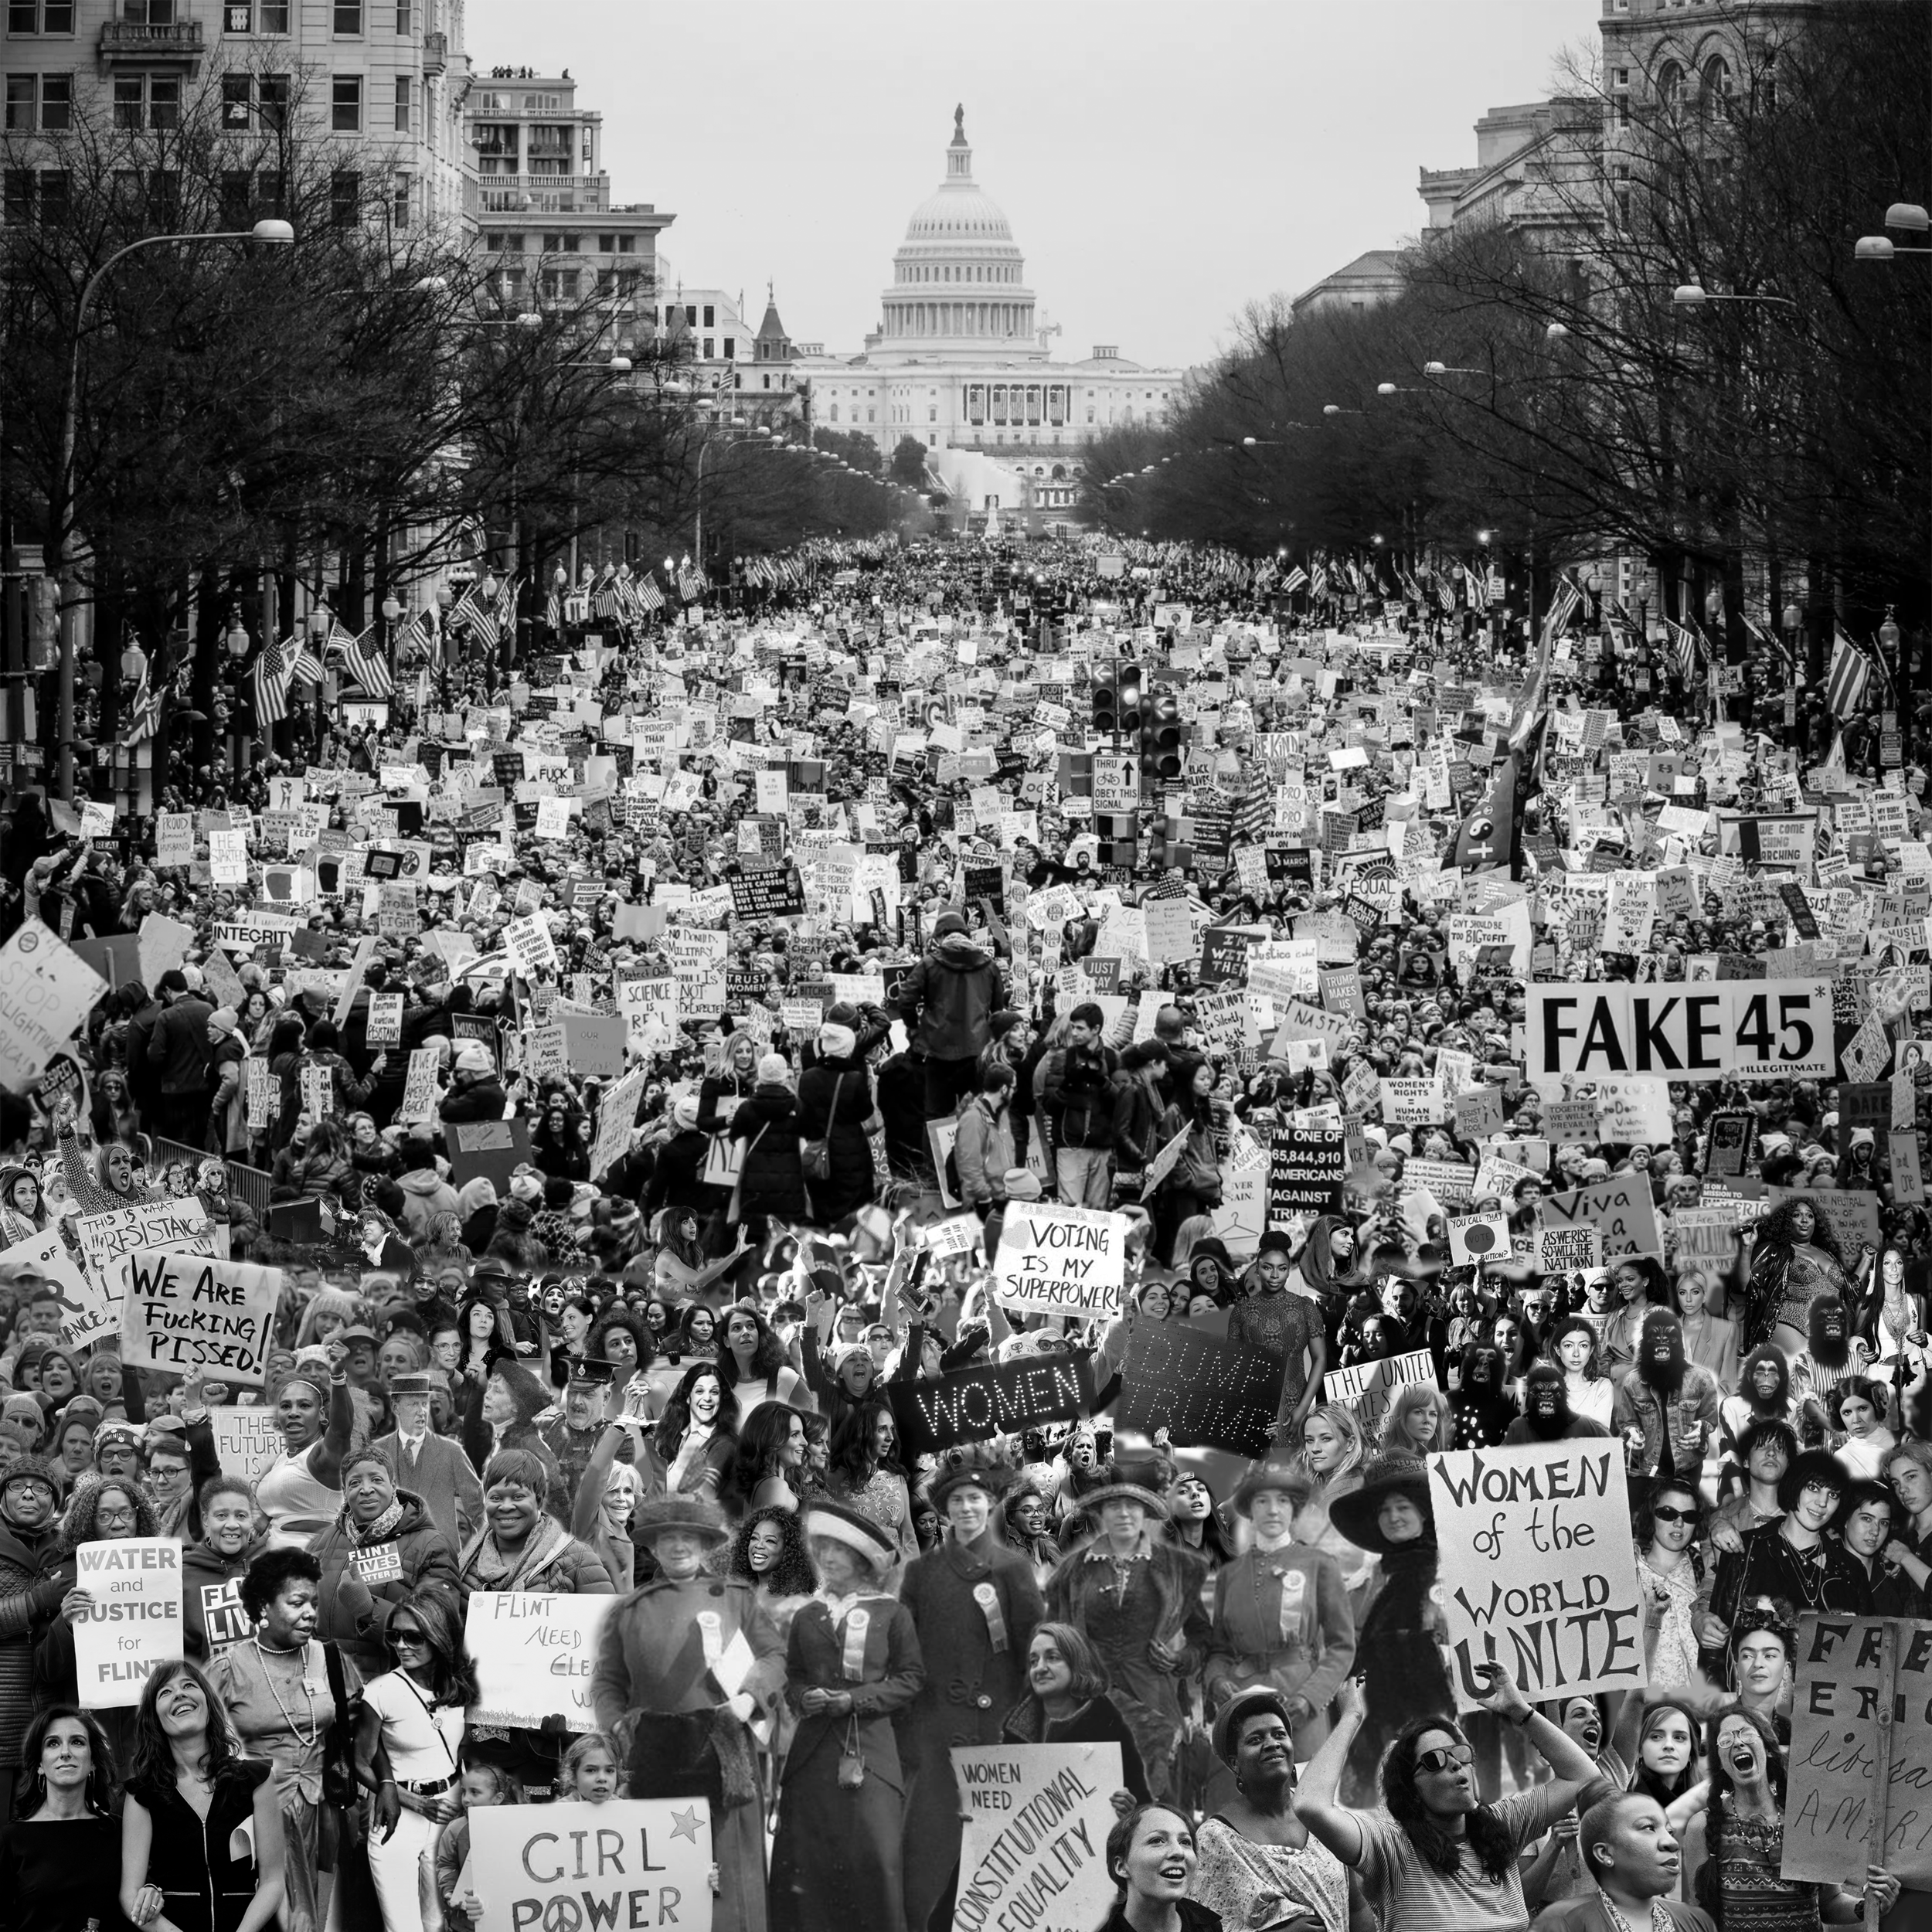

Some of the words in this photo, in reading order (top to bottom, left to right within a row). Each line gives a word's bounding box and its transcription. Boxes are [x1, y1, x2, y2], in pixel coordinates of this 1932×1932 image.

[634, 722, 674, 733] STRONGER
[1254, 735, 1270, 760] BE
[1096, 759, 1117, 769] THRU
[540, 768, 567, 780] FUCK
[1095, 789, 1117, 798] OBEY
[1120, 789, 1138, 799] THIS
[1281, 787, 1301, 799] PRO
[1095, 800, 1123, 809] SIGNAL
[370, 808, 395, 819] NASTY
[1281, 811, 1301, 823] PRO
[162, 817, 189, 830] PROUD
[369, 819, 397, 829] WOMEN
[539, 819, 562, 830] RISE
[1760, 825, 1774, 835] WE
[1778, 824, 1804, 835] COME
[293, 829, 317, 838] KEEP
[321, 832, 347, 842] WOMEN
[160, 842, 190, 852] HUSBAND
[217, 834, 234, 849] HE
[210, 849, 246, 865] STARTED
[959, 853, 997, 867] HISTORY
[1284, 858, 1308, 866] MARCH
[219, 866, 238, 878] IT
[744, 873, 761, 882] MAY
[762, 872, 779, 880] NOT
[754, 878, 785, 887] CHOSEN
[1352, 880, 1396, 894] EQUAL
[736, 896, 750, 905] BUT
[768, 893, 787, 901] TIME
[750, 887, 769, 896] TIME
[380, 900, 414, 911] STORM
[755, 900, 785, 910] CHOSEN
[1348, 897, 1379, 921] HEALTH
[1881, 898, 1899, 913] THE
[380, 917, 417, 928] LIGHT
[1346, 906, 1376, 927] EQUITY
[511, 927, 536, 944] LONGER
[1223, 934, 1247, 947] I'M
[1451, 932, 1464, 940] TOO
[1465, 929, 1483, 944] BIG
[1492, 934, 1508, 943] FIT
[1573, 936, 1594, 950] HER
[526, 941, 548, 955] THINGS
[668, 940, 713, 957] MILITARY
[525, 950, 549, 965] CANNOT
[1089, 963, 1115, 975] JUST
[727, 974, 766, 985] TRUST
[1325, 975, 1355, 988] TRUMP
[0, 961, 60, 1016] STOP
[628, 982, 671, 1003] SCIENCE
[681, 984, 706, 999] NOT
[726, 982, 767, 993] WOMEN
[800, 985, 833, 995] BITCHES
[1328, 987, 1357, 998] MAKES
[1226, 992, 1244, 1007] NOT
[1294, 1007, 1345, 1036] NASTY
[455, 1021, 495, 1039] MUSLIMS
[1543, 995, 1721, 1073] FAKE
[533, 1058, 563, 1068] HUMAN
[408, 1071, 436, 1083] MAKE
[1388, 1080, 1435, 1089] WOMEN'S
[406, 1083, 434, 1098] AMERICA
[404, 1098, 430, 1114] GREAT
[1458, 1108, 1481, 1119] RESIST
[1549, 1104, 1594, 1114] TOGETHER
[1396, 1114, 1430, 1123] RIGHTS
[1565, 1112, 1586, 1121] WILL
[1272, 1128, 1289, 1141] I'M
[1294, 1131, 1322, 1143] ONE
[1324, 1131, 1343, 1143] OF
[1272, 1150, 1342, 1165] 65,844,910
[1271, 1168, 1345, 1182] AMERICANS
[1272, 1189, 1332, 1204] AGAINST
[1703, 1190, 1733, 1199] MISSION
[1549, 1191, 1631, 1220] Viva
[83, 1214, 117, 1233] THIS
[124, 1208, 137, 1224] IS
[143, 1201, 176, 1216] WHAT
[1451, 1218, 1467, 1229] YOU
[1468, 1215, 1482, 1225] CALL
[1485, 1213, 1503, 1221] THAT
[105, 1216, 207, 1259] RESISTANCE
[946, 1236, 958, 1250] VOTE
[956, 1233, 969, 1249] VOICE
[1029, 1219, 1110, 1256] VOTING
[1469, 1232, 1492, 1243] VOTE
[1468, 1254, 1475, 1263] A
[1543, 1255, 1594, 1271] NATION
[1022, 1255, 1048, 1273] IS
[1063, 1257, 1094, 1278] MY
[130, 1253, 179, 1299] WE
[192, 1266, 246, 1306] ARE
[1002, 1274, 1121, 1316] SUPERPOWER!
[141, 1301, 257, 1343] FUCKING
[146, 1312, 272, 1376] PISSED!
[1324, 1366, 1369, 1399] THE
[1380, 1351, 1435, 1388] UNITED
[917, 1362, 1081, 1437] WOMEN
[233, 1415, 275, 1435] THE
[101, 1432, 127, 1445] FEMINIST
[245, 1458, 261, 1475] IS
[1434, 1451, 1611, 1509] WOMEN
[1472, 1512, 1506, 1560] of
[1524, 1504, 1595, 1553] the
[80, 1547, 177, 1572] WATER
[348, 1543, 390, 1561] FLINT
[359, 1555, 398, 1573] IVES
[111, 1577, 144, 1593] and
[1454, 1574, 1610, 1628] WORLD
[78, 1601, 178, 1624] JUSTICE
[117, 1636, 141, 1651] for
[525, 1625, 583, 1650] NEED
[1454, 1604, 1641, 1700] UNITE
[98, 1659, 165, 1682] FLINT
[962, 1763, 1022, 1784] WOMEN
[971, 1790, 1012, 1811] NEED
[522, 1827, 667, 1884] GIRL
[954, 1766, 1098, 1932] CONSTITUTIONAL
[997, 1818, 1097, 1932] EQUALITY
